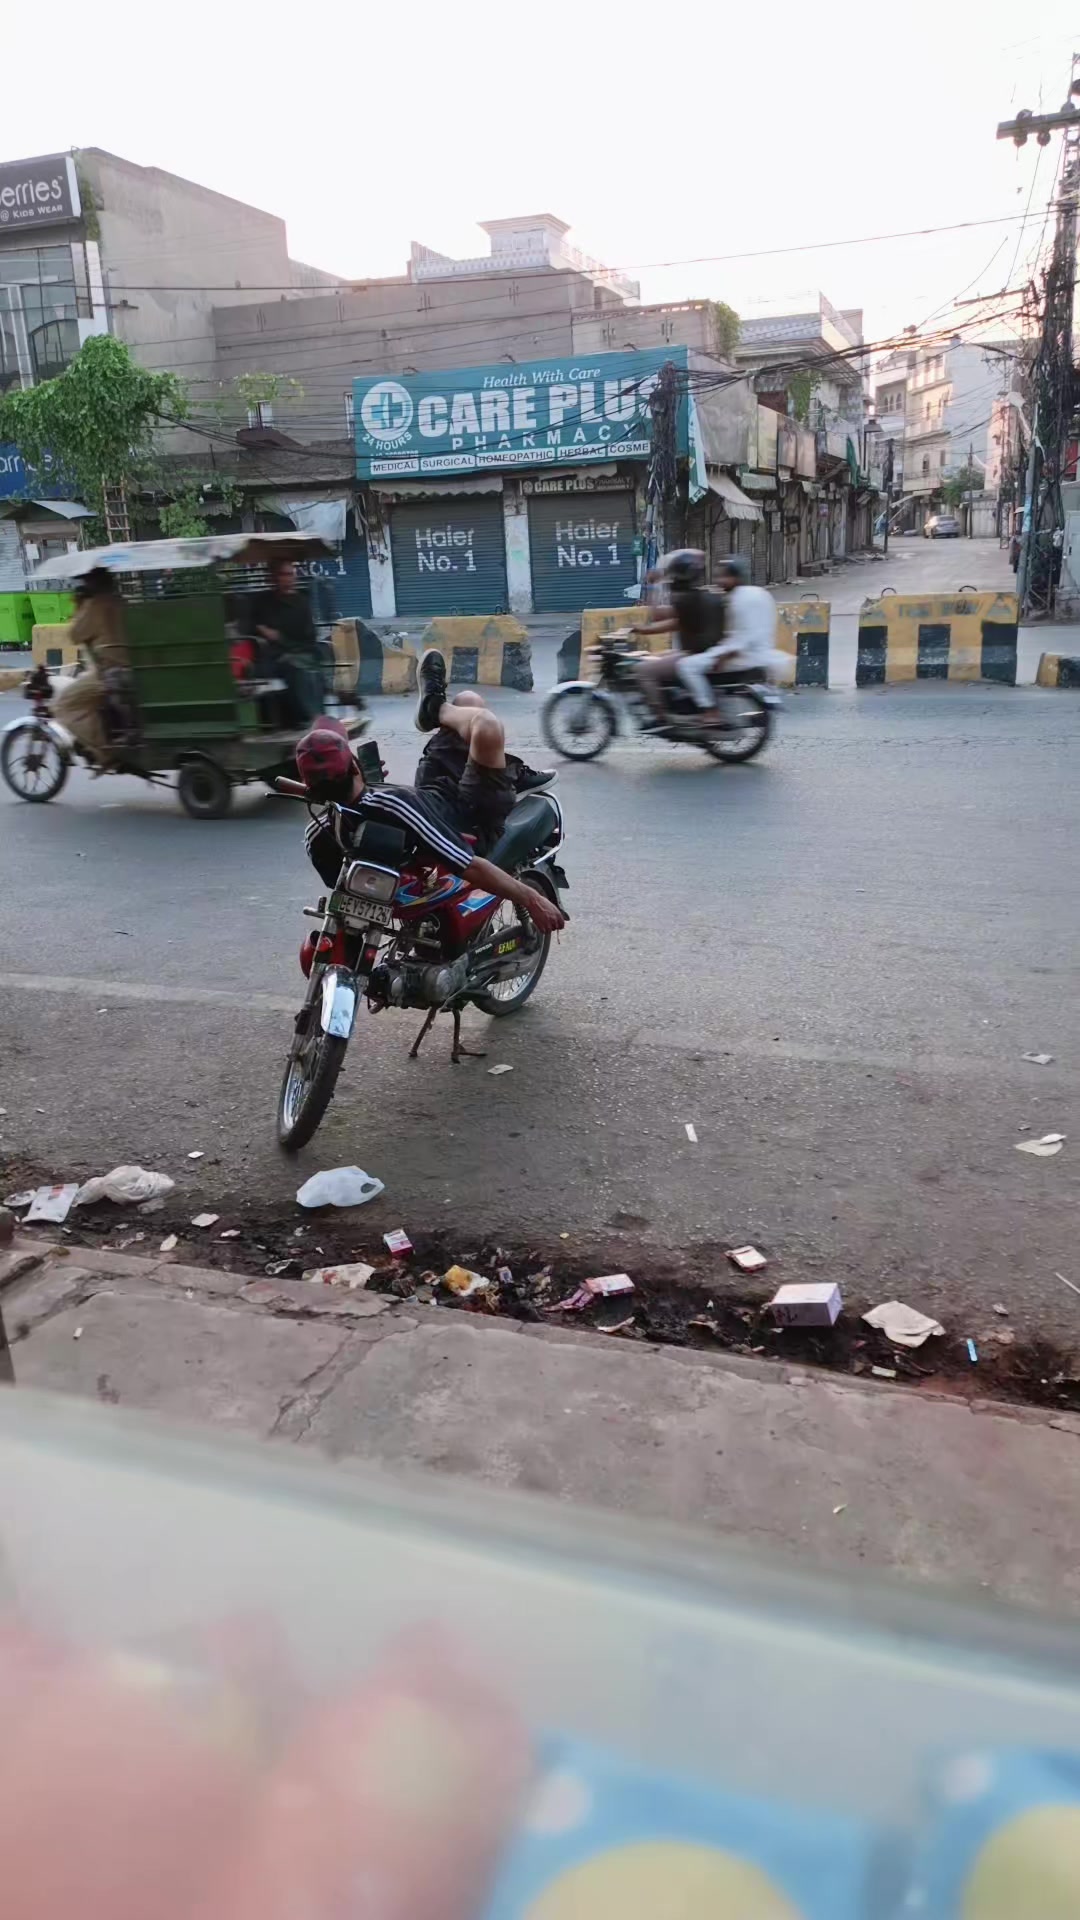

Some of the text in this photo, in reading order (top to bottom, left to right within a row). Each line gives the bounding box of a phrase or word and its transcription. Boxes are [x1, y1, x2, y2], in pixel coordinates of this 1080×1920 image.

[0, 179, 62, 207] erries
[37, 204, 63, 214] WEAR
[483, 368, 601, 388] Health With Care
[417, 387, 537, 438] CARE
[375, 431, 413, 450] HOURS
[452, 423, 635, 451] PHARMACY
[373, 460, 417, 472] MEDICAL
[422, 457, 474, 468] SURGICAL
[479, 450, 553, 464] HOMEOPATHIC
[560, 447, 602, 457] HERBAL
[534, 480, 564, 492] CARE
[565, 479, 595, 490] PLUS
[415, 526, 474, 549] Haier
[554, 519, 620, 541] Haier
[335, 556, 347, 575] 1
[416, 549, 477, 572] No. 1
[556, 543, 621, 567] No. 1
